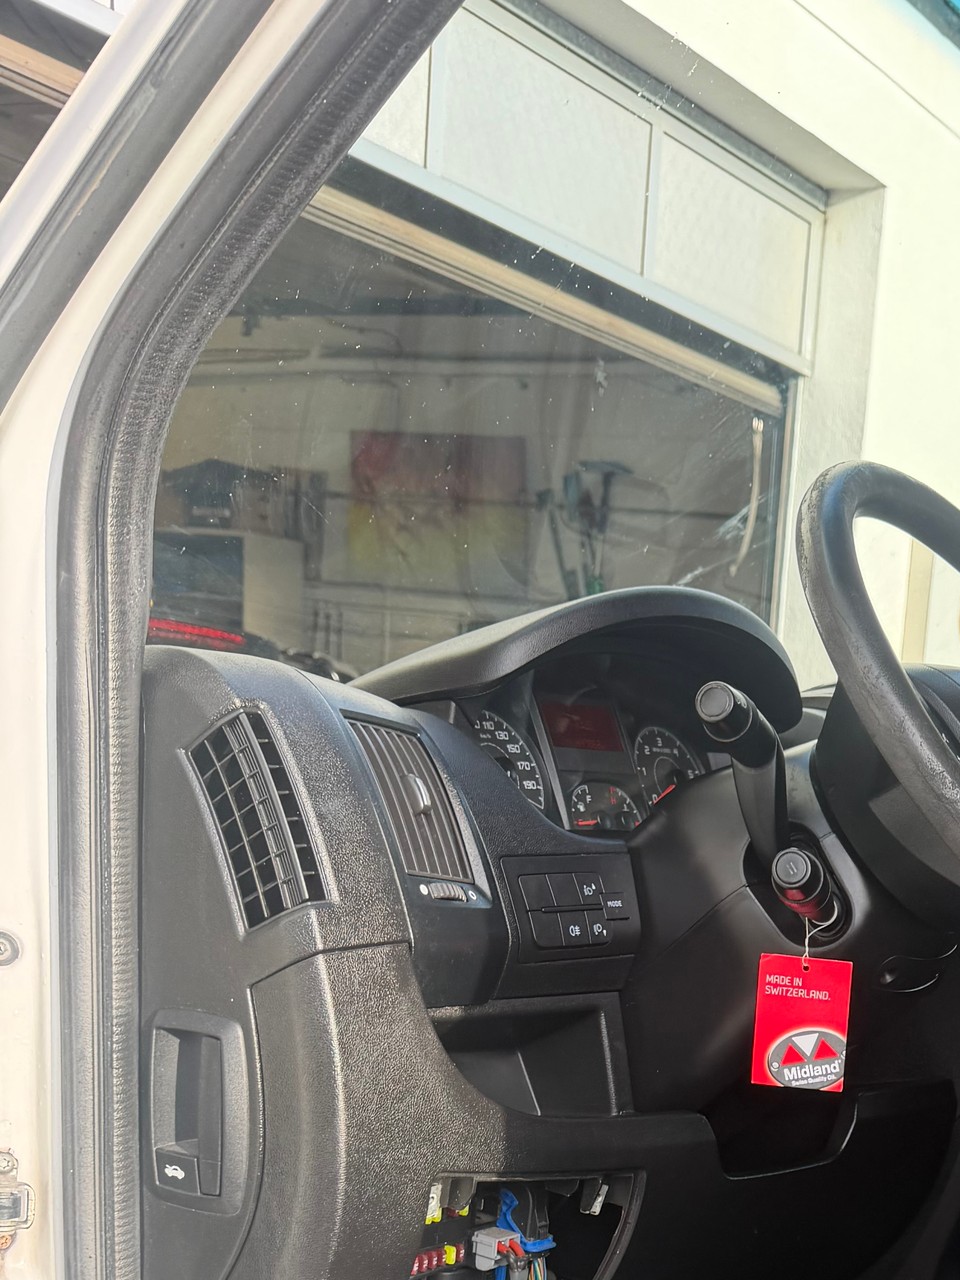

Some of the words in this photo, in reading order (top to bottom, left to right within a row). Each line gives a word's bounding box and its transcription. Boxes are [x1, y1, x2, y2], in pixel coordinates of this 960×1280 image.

[495, 731, 508, 740] 130
[507, 744, 520, 753] 150
[644, 745, 651, 755] 2
[517, 761, 531, 770] 170
[523, 781, 536, 790] 190
[586, 795, 592, 804] F
[766, 974, 792, 986] MADE
[793, 977, 803, 987] IN
[765, 985, 831, 1001] SWITZERLAND.
[784, 1060, 840, 1080] Midland
